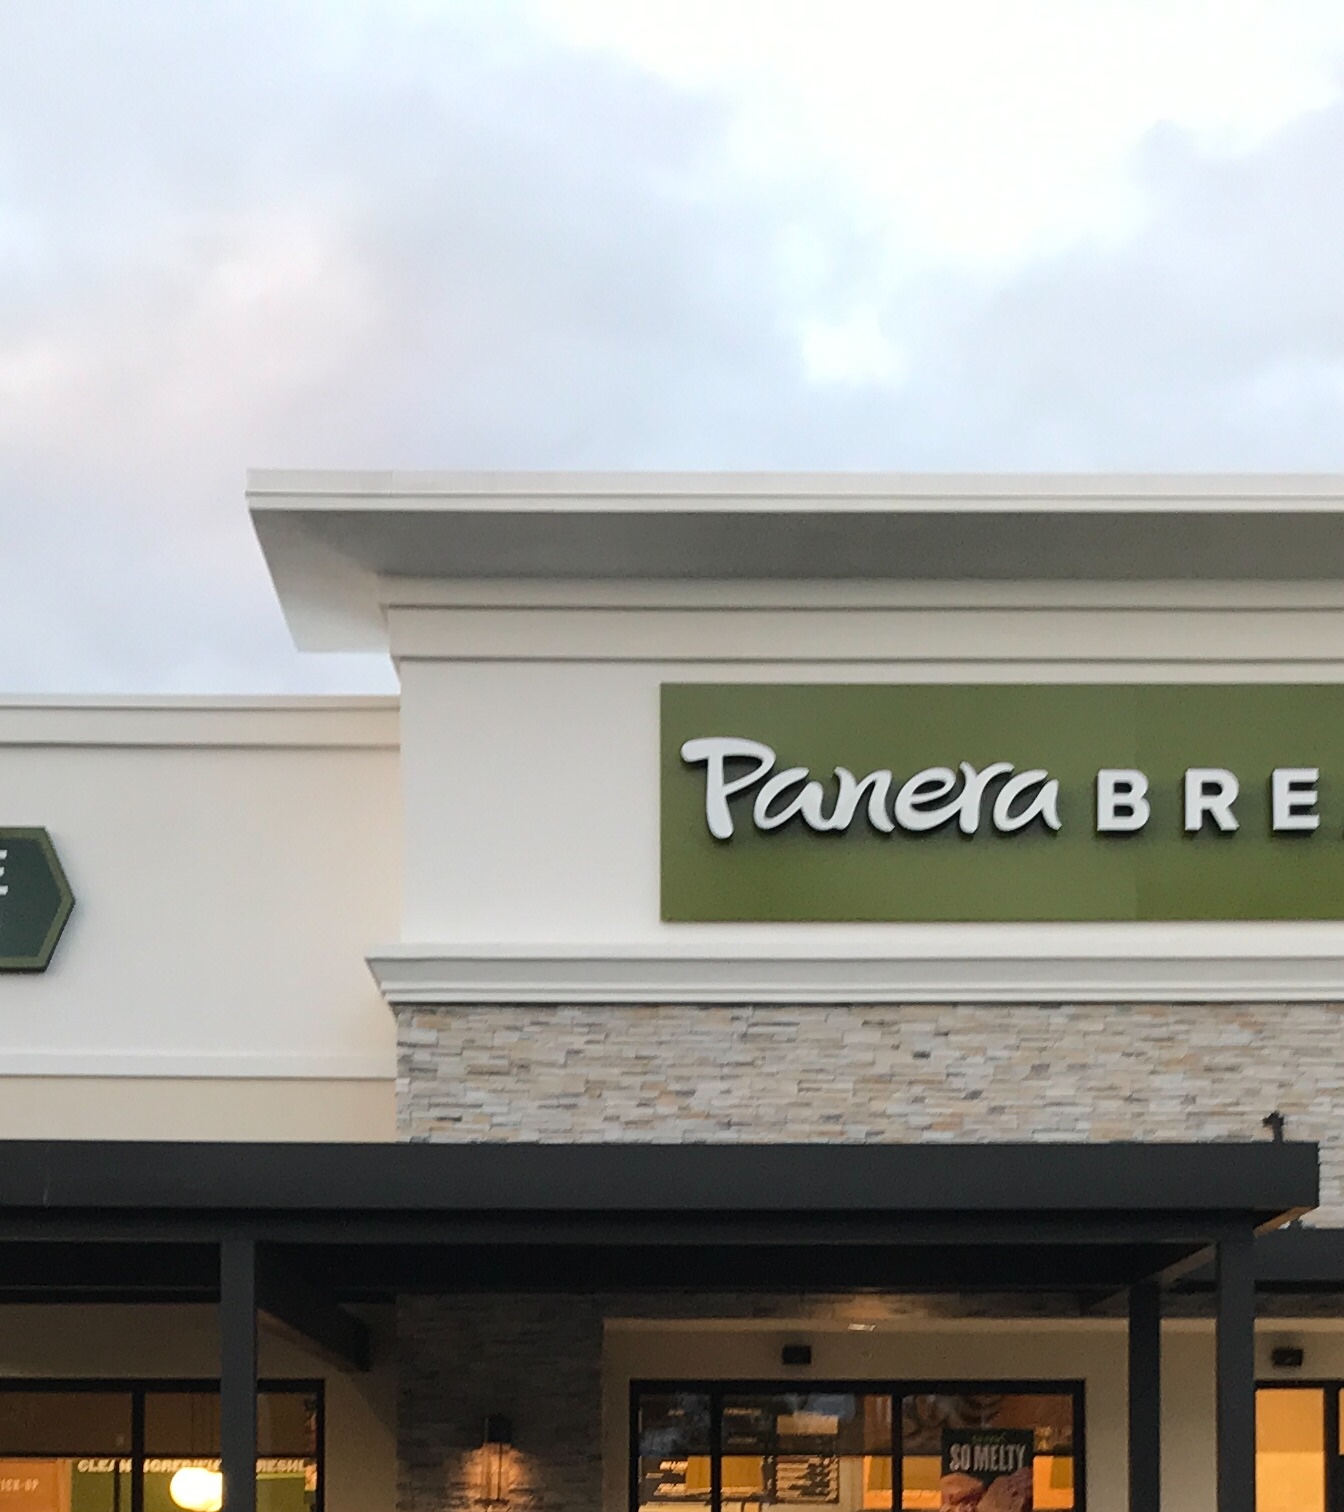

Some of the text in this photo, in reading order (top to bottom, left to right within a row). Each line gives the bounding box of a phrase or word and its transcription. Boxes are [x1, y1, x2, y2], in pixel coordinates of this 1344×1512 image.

[681, 737, 1062, 838] Panera
[950, 1443, 1026, 1471] SO MELTY
